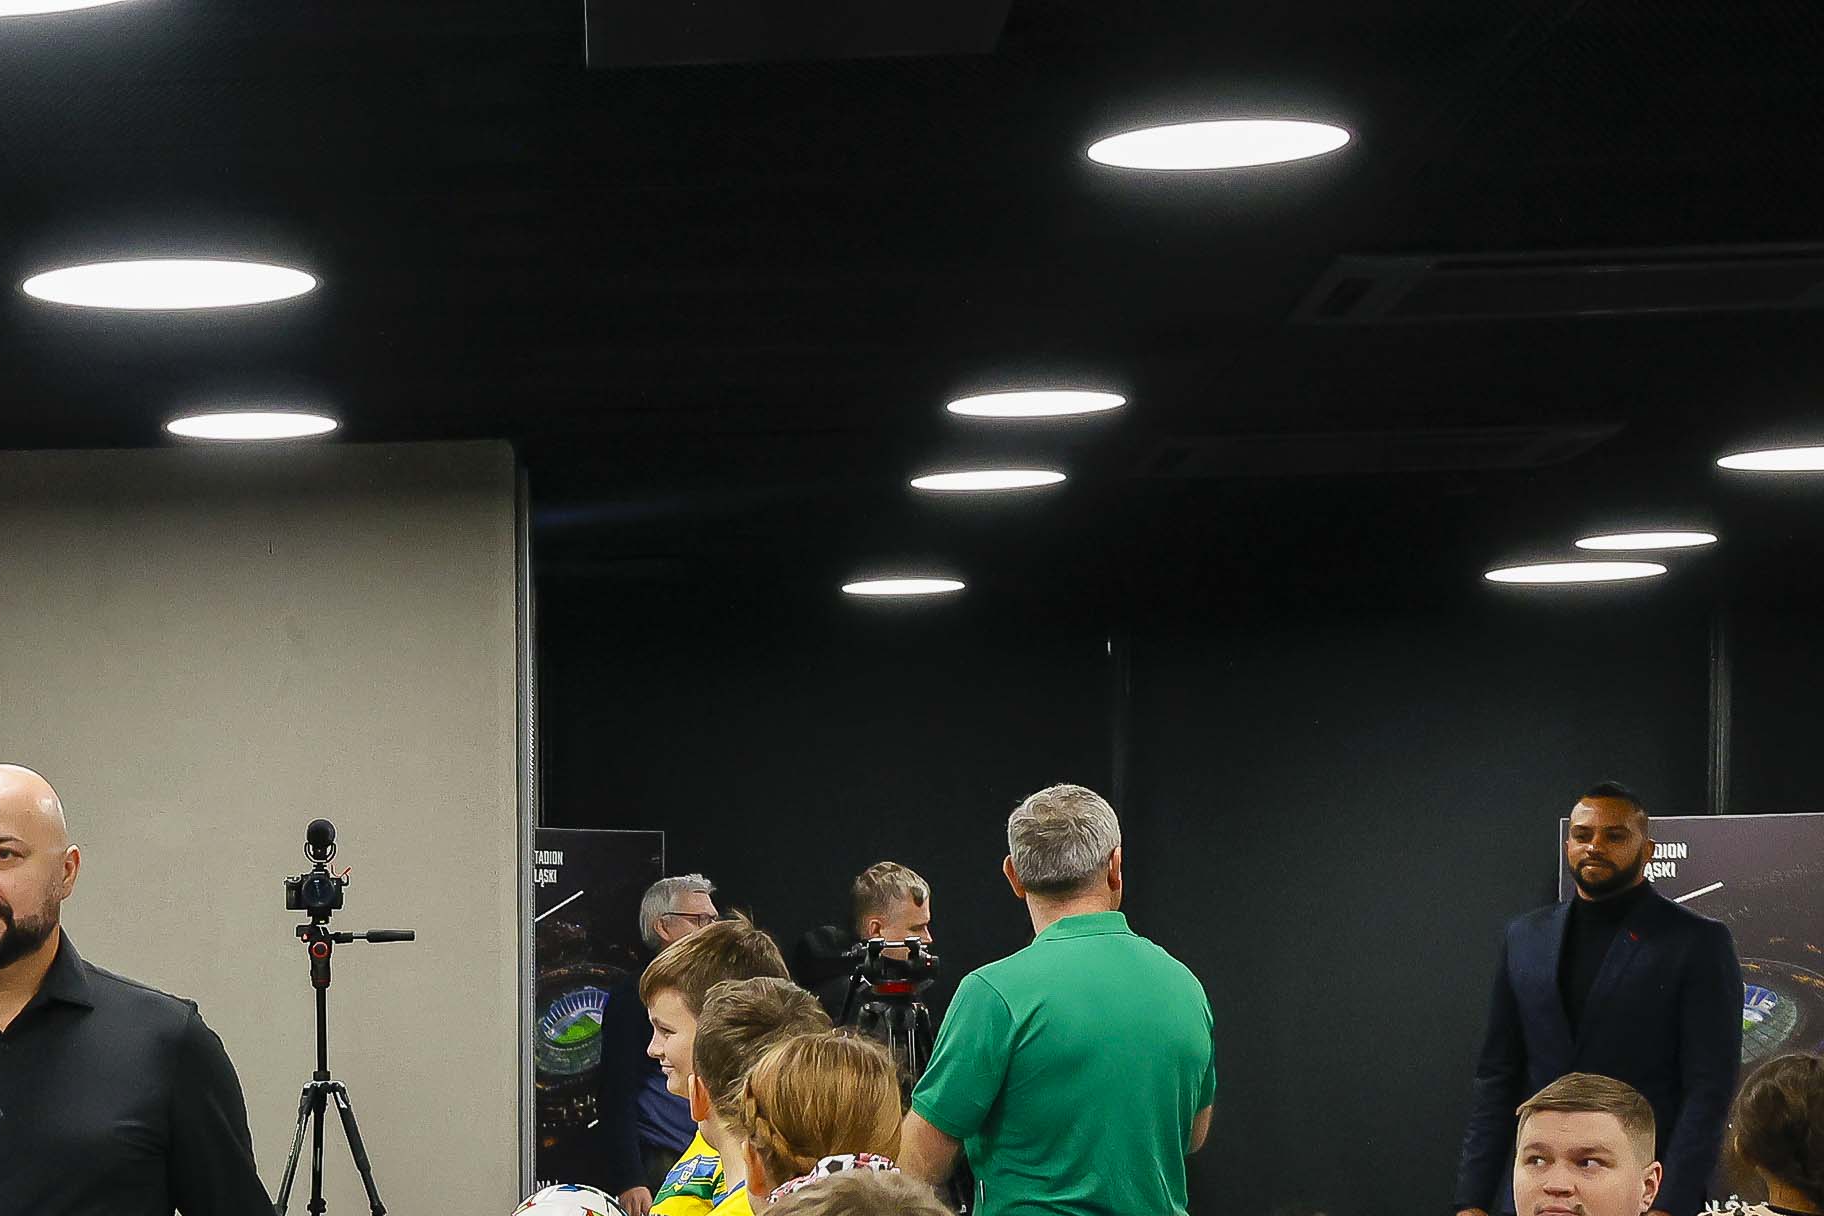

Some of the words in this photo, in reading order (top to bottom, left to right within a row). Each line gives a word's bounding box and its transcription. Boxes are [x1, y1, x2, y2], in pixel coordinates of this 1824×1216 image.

[534, 850, 563, 865] TADION
[1652, 843, 1687, 859] DION
[534, 869, 557, 887] LĄSKI
[1643, 861, 1676, 882] ĄSKI
